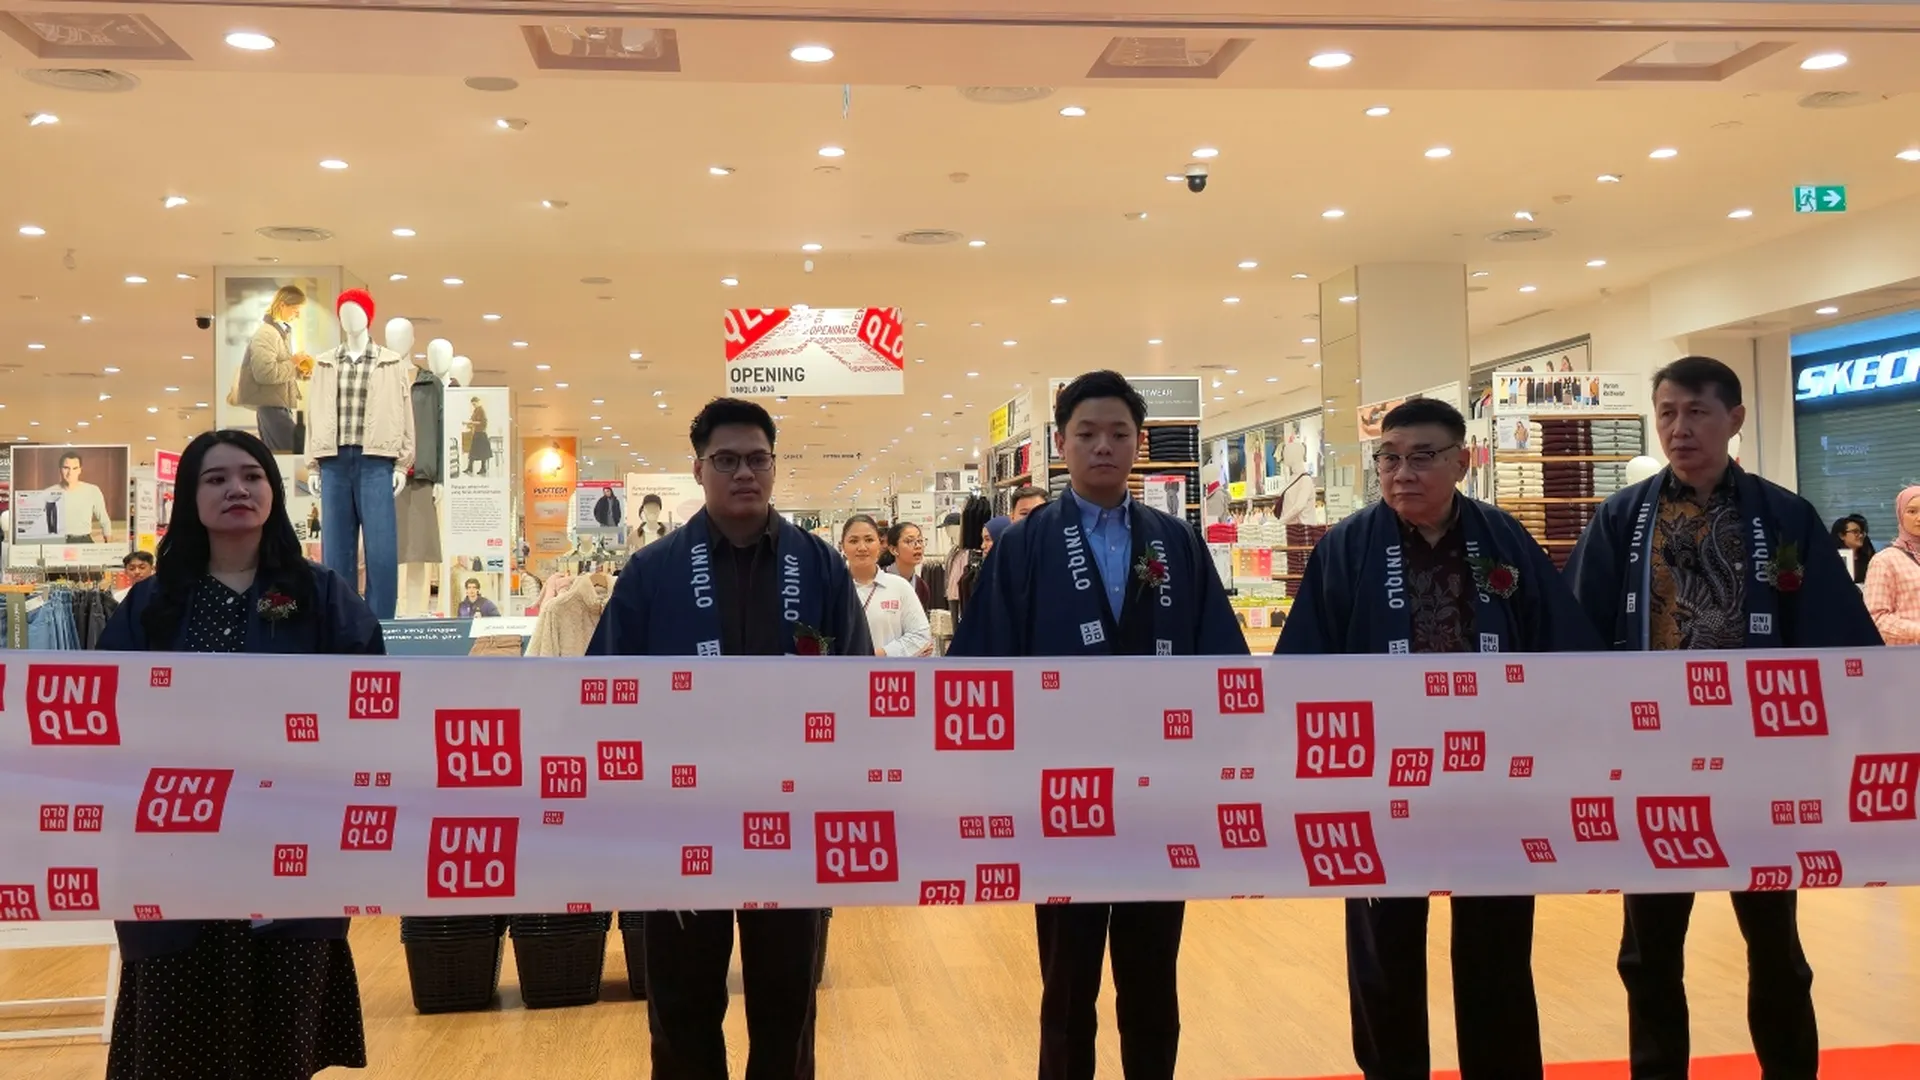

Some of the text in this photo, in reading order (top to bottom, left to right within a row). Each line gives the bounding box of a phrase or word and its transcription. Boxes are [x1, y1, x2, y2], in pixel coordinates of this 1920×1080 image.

[724, 308, 775, 344] QL
[809, 325, 849, 336] OPENING
[730, 366, 806, 384] OPENING
[731, 385, 758, 394] UNIQLO
[1063, 525, 1091, 590] UNIQLO
[690, 543, 713, 608] UNIQLO
[1384, 545, 1404, 609] UNIQLO
[781, 554, 800, 621] UNIQLO
[1752, 616, 1768, 624] UNI
[1752, 624, 1770, 632] QLO
[1224, 674, 1254, 689] UNI
[1692, 668, 1720, 682] UNI
[1756, 670, 1808, 696] UNI
[37, 676, 100, 704] UNI
[356, 678, 390, 694] UNI
[875, 678, 906, 692] UNI
[944, 680, 998, 707] UNI
[1224, 692, 1258, 710] QLO
[1692, 686, 1726, 703] QLO
[354, 696, 394, 714] QLO
[874, 696, 910, 713] QLO
[1760, 700, 1818, 730] QLO
[40, 710, 107, 739] QLO
[445, 720, 504, 746] UNI
[944, 714, 1005, 744] QLO
[1306, 712, 1360, 738] UNI
[1448, 736, 1478, 751] UNI
[602, 746, 634, 760] UNI
[1306, 744, 1365, 772] QLO
[1396, 752, 1428, 768] QLO
[1449, 754, 1480, 769] QLO
[448, 752, 512, 782] QLO
[546, 760, 582, 775] QLO
[603, 762, 637, 776] QLO
[1859, 764, 1907, 784] UNI
[1397, 770, 1426, 782] UNI
[155, 776, 214, 794] UNI
[549, 778, 582, 792] UNI
[1050, 777, 1099, 800] UNI
[1856, 788, 1907, 816] QLO
[148, 798, 213, 826] QLO
[350, 810, 386, 825] UNI
[1050, 804, 1104, 832] QLO
[1224, 810, 1254, 825] UNI
[1576, 804, 1606, 819] UNI
[1646, 807, 1698, 832] UNI
[749, 818, 781, 830] UNI
[824, 822, 880, 842] UNI
[1578, 822, 1612, 838] QLO
[348, 828, 387, 846] QLO
[440, 827, 501, 853] UNI
[749, 833, 785, 846] QLO
[1226, 828, 1262, 845] QLO
[1305, 824, 1360, 848] UNI
[1654, 837, 1714, 862] QLO
[826, 848, 888, 877] QLO
[1313, 852, 1373, 879] QLO
[1803, 855, 1835, 870] UNI
[54, 874, 88, 890] UNI
[438, 860, 504, 892] QLO
[982, 869, 1012, 884] UNI
[1756, 869, 1788, 885] QLO
[1806, 873, 1838, 886] QLO
[0, 888, 29, 905] QL
[926, 883, 960, 899] QLO
[981, 887, 1015, 900] QLO
[54, 892, 93, 908] QLO
[0, 907, 33, 918] UN
